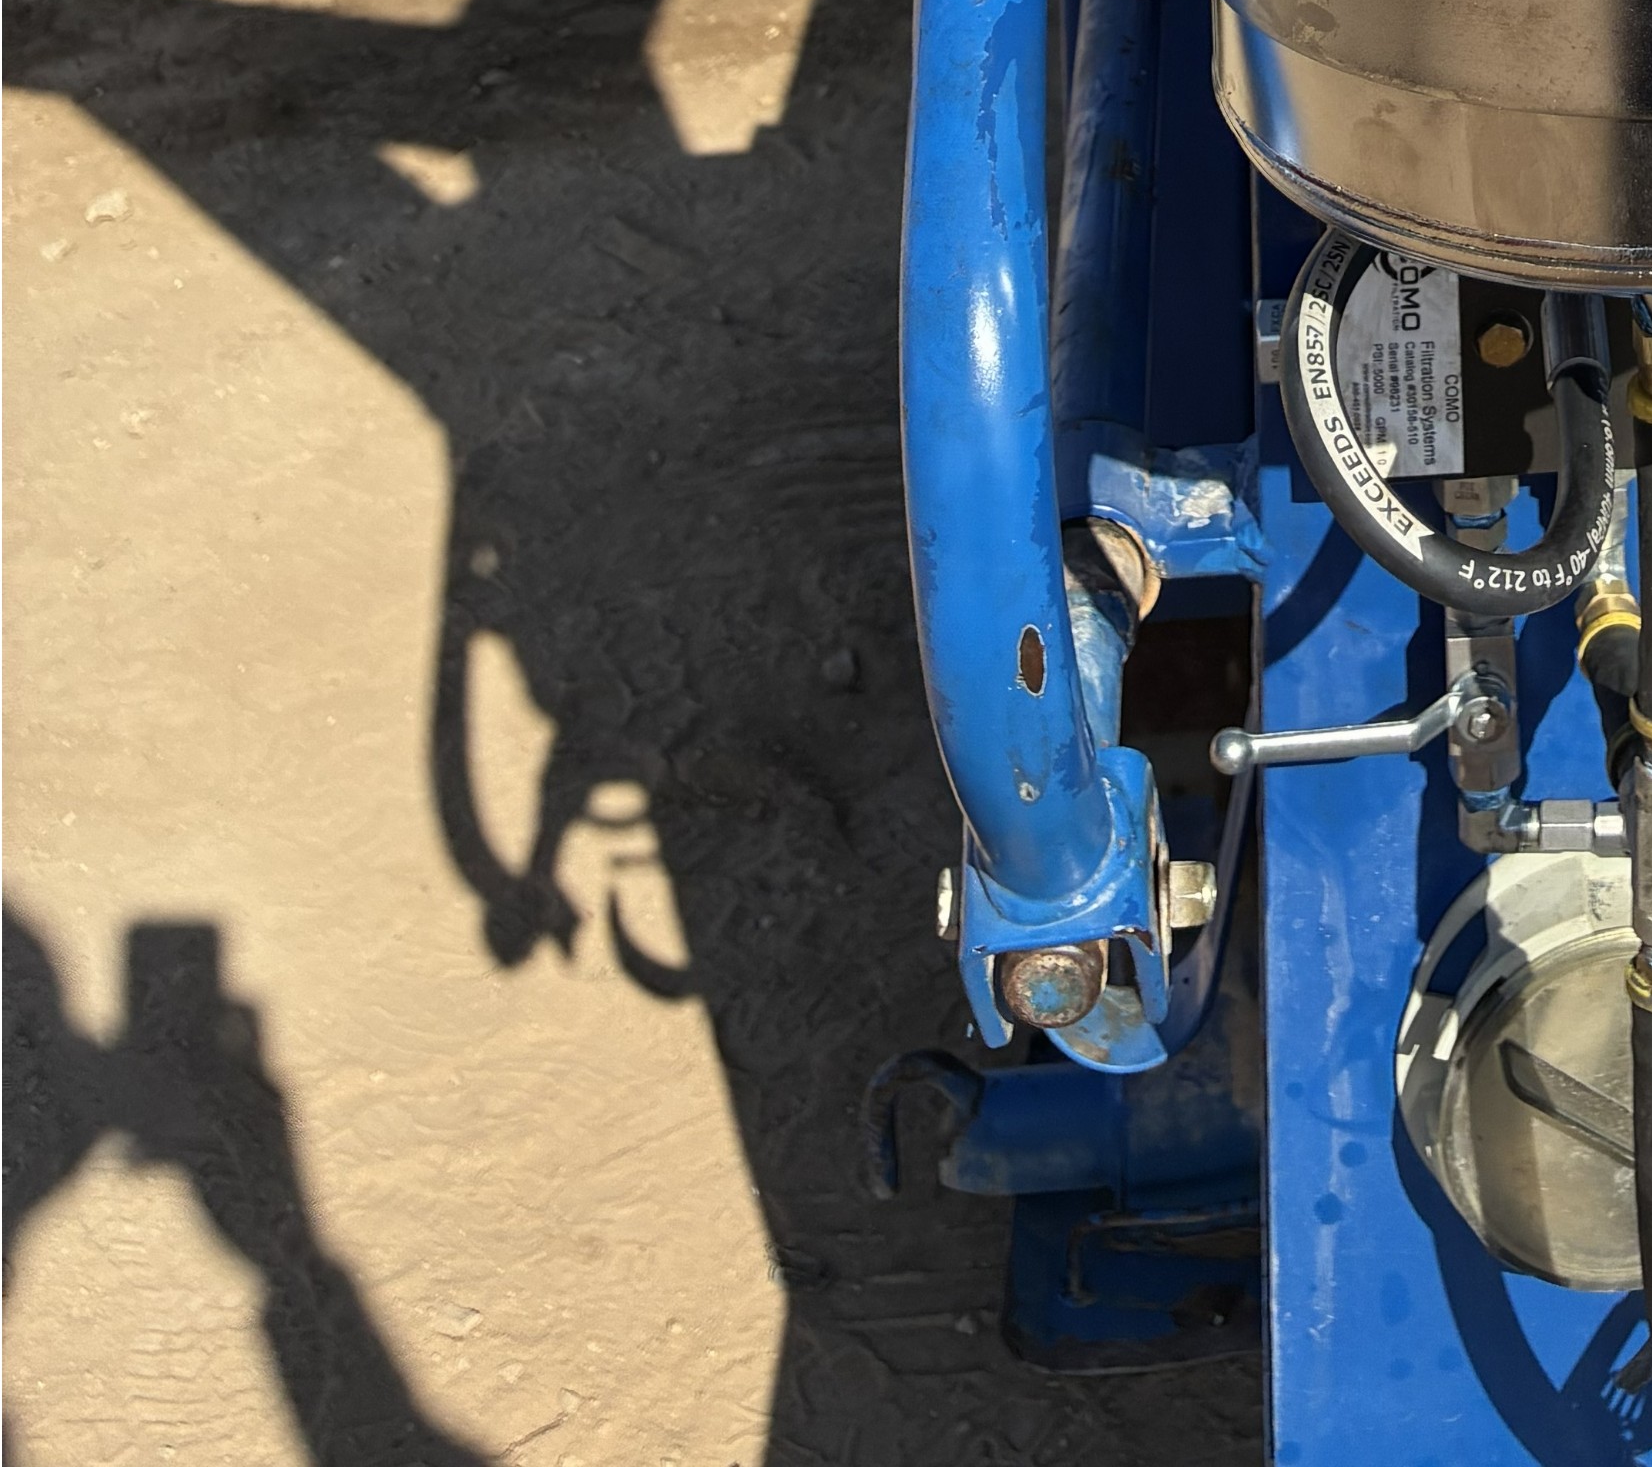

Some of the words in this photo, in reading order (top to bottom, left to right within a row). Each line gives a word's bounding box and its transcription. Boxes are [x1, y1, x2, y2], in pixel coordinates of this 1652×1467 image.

[1388, 342, 1400, 371] Serial
[1403, 341, 1416, 383] Catalog
[1420, 340, 1435, 403] Filtration
[1444, 373, 1461, 424] COMO
[1421, 405, 1437, 466] Systems
[1323, 415, 1415, 537] EXCEEDS
[1532, 568, 1551, 588] to
